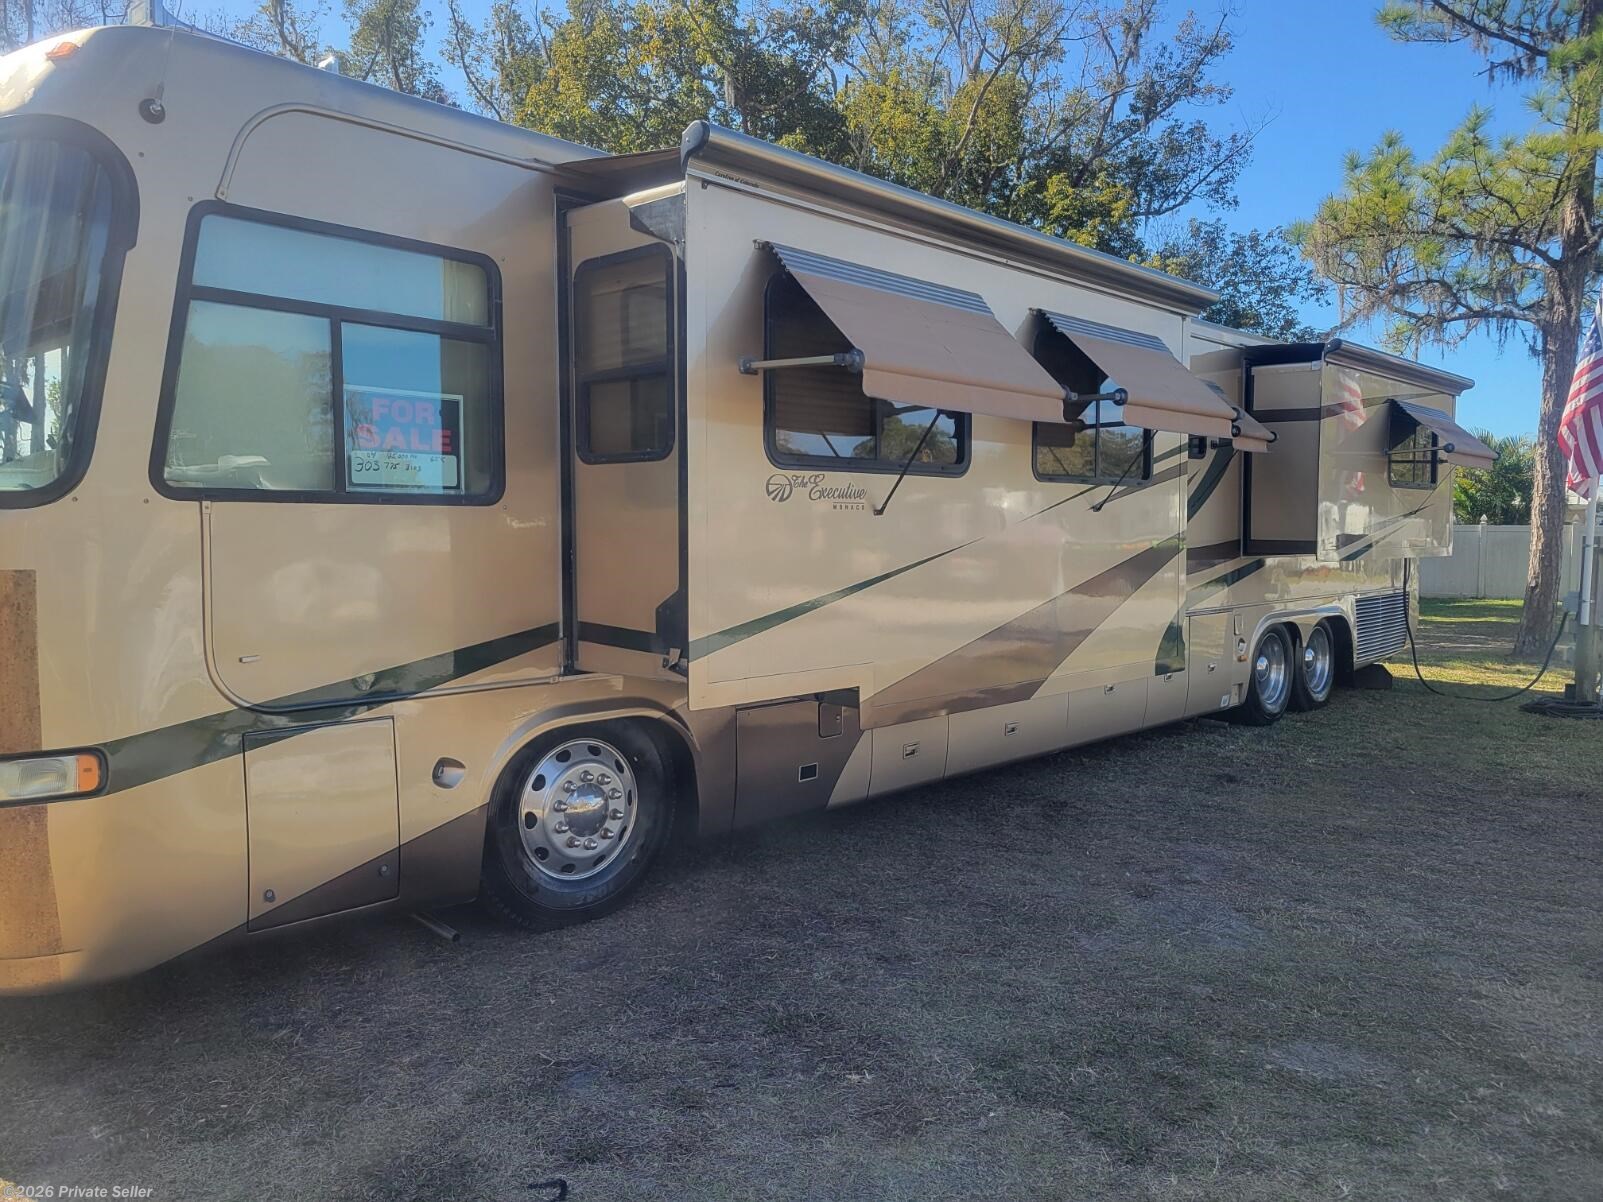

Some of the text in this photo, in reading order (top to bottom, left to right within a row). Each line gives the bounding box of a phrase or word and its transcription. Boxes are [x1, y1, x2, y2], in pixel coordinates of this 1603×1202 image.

[371, 398, 435, 424] FOR
[357, 423, 452, 452] SALE
[353, 456, 380, 472] 303
[791, 473, 867, 501] The Executive
